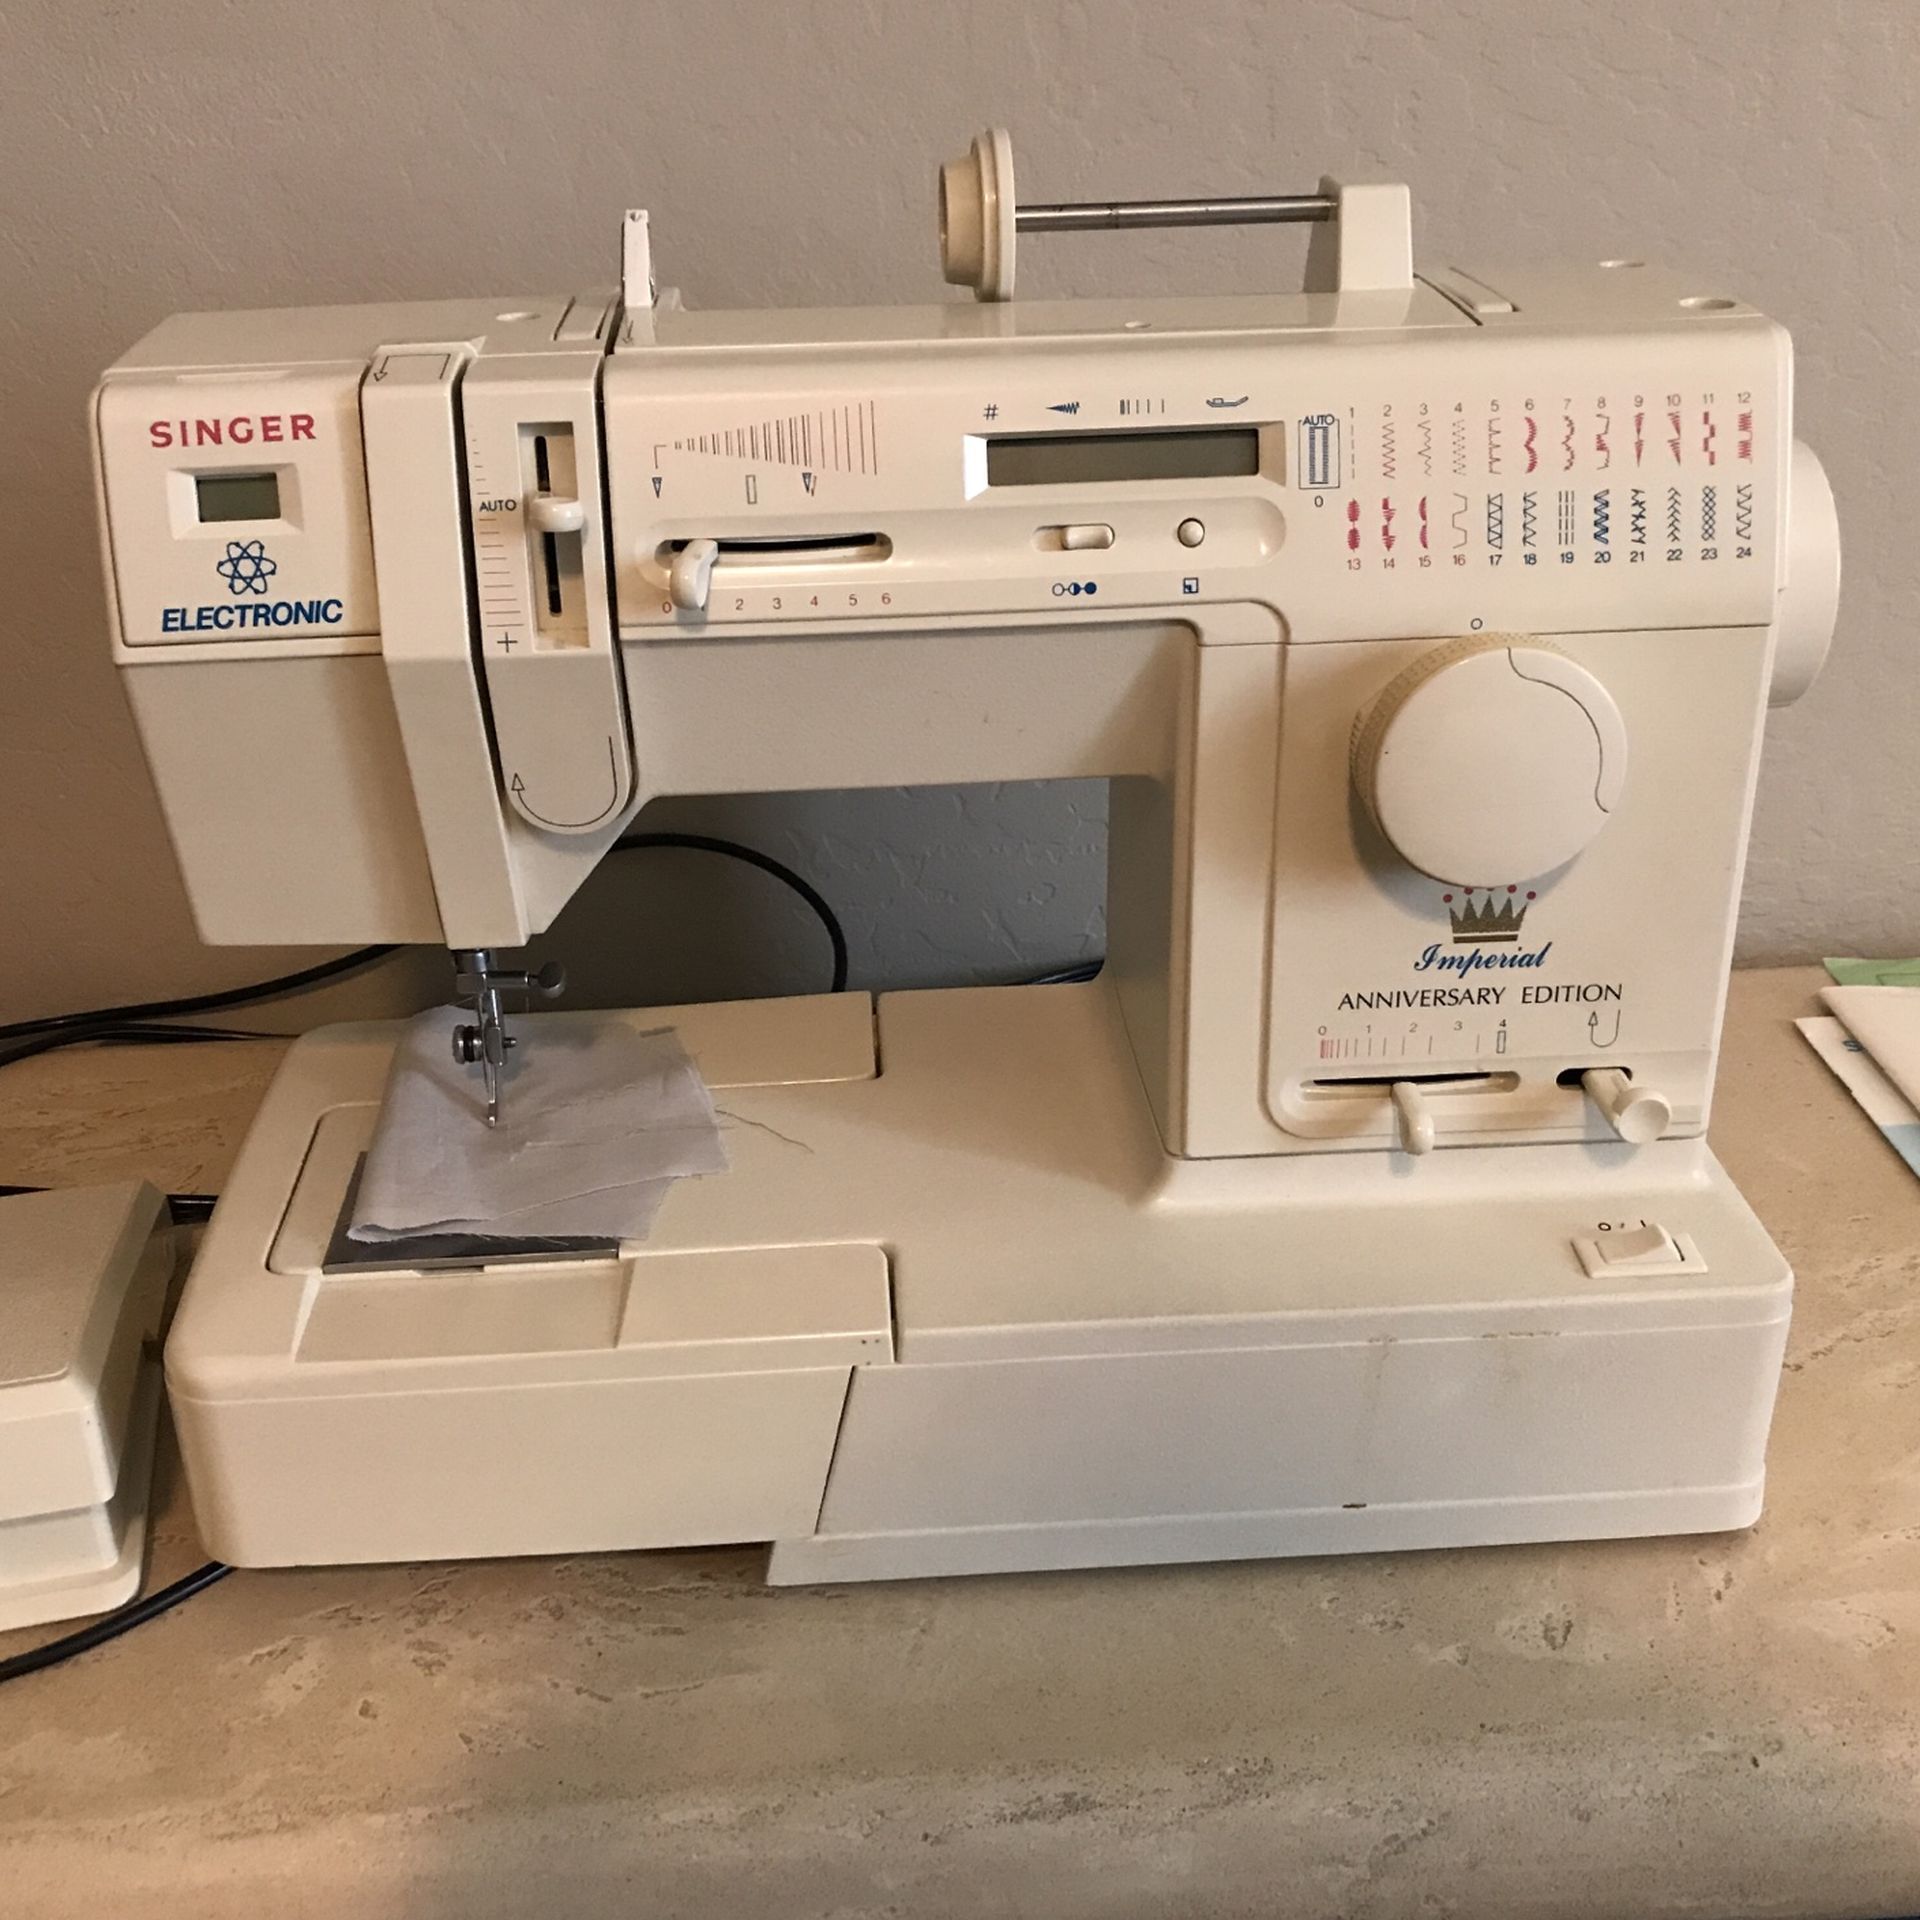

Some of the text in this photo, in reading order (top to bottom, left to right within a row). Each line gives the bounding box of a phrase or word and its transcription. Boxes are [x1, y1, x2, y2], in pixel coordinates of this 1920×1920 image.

[1383, 404, 1393, 418] 2
[1419, 402, 1429, 417] 3
[1453, 402, 1463, 413] 4
[1490, 398, 1500, 413] 5
[1524, 398, 1535, 411] 6
[1563, 397, 1572, 410] 7
[1596, 396, 1607, 410] 8
[1634, 394, 1644, 408] 9
[1666, 393, 1682, 407] 10
[1702, 392, 1715, 405] 11
[1737, 391, 1751, 404] 12
[150, 414, 316, 447] SINGER
[1302, 413, 1336, 426] AUTO
[479, 499, 517, 512] AUTO
[1346, 546, 1752, 571] 13 14 15 16 17 18 19 20 21 22 23 24
[162, 599, 343, 632] ELECTRONIC
[661, 592, 892, 614] 0 2 3 4 5 6
[1414, 942, 1552, 978] Imperial
[1338, 984, 1622, 1010] ANNIVERSARY EDITION
[1408, 1022, 1419, 1034] 2
[1453, 1020, 1464, 1031] 3
[1499, 1018, 1507, 1028] 4
